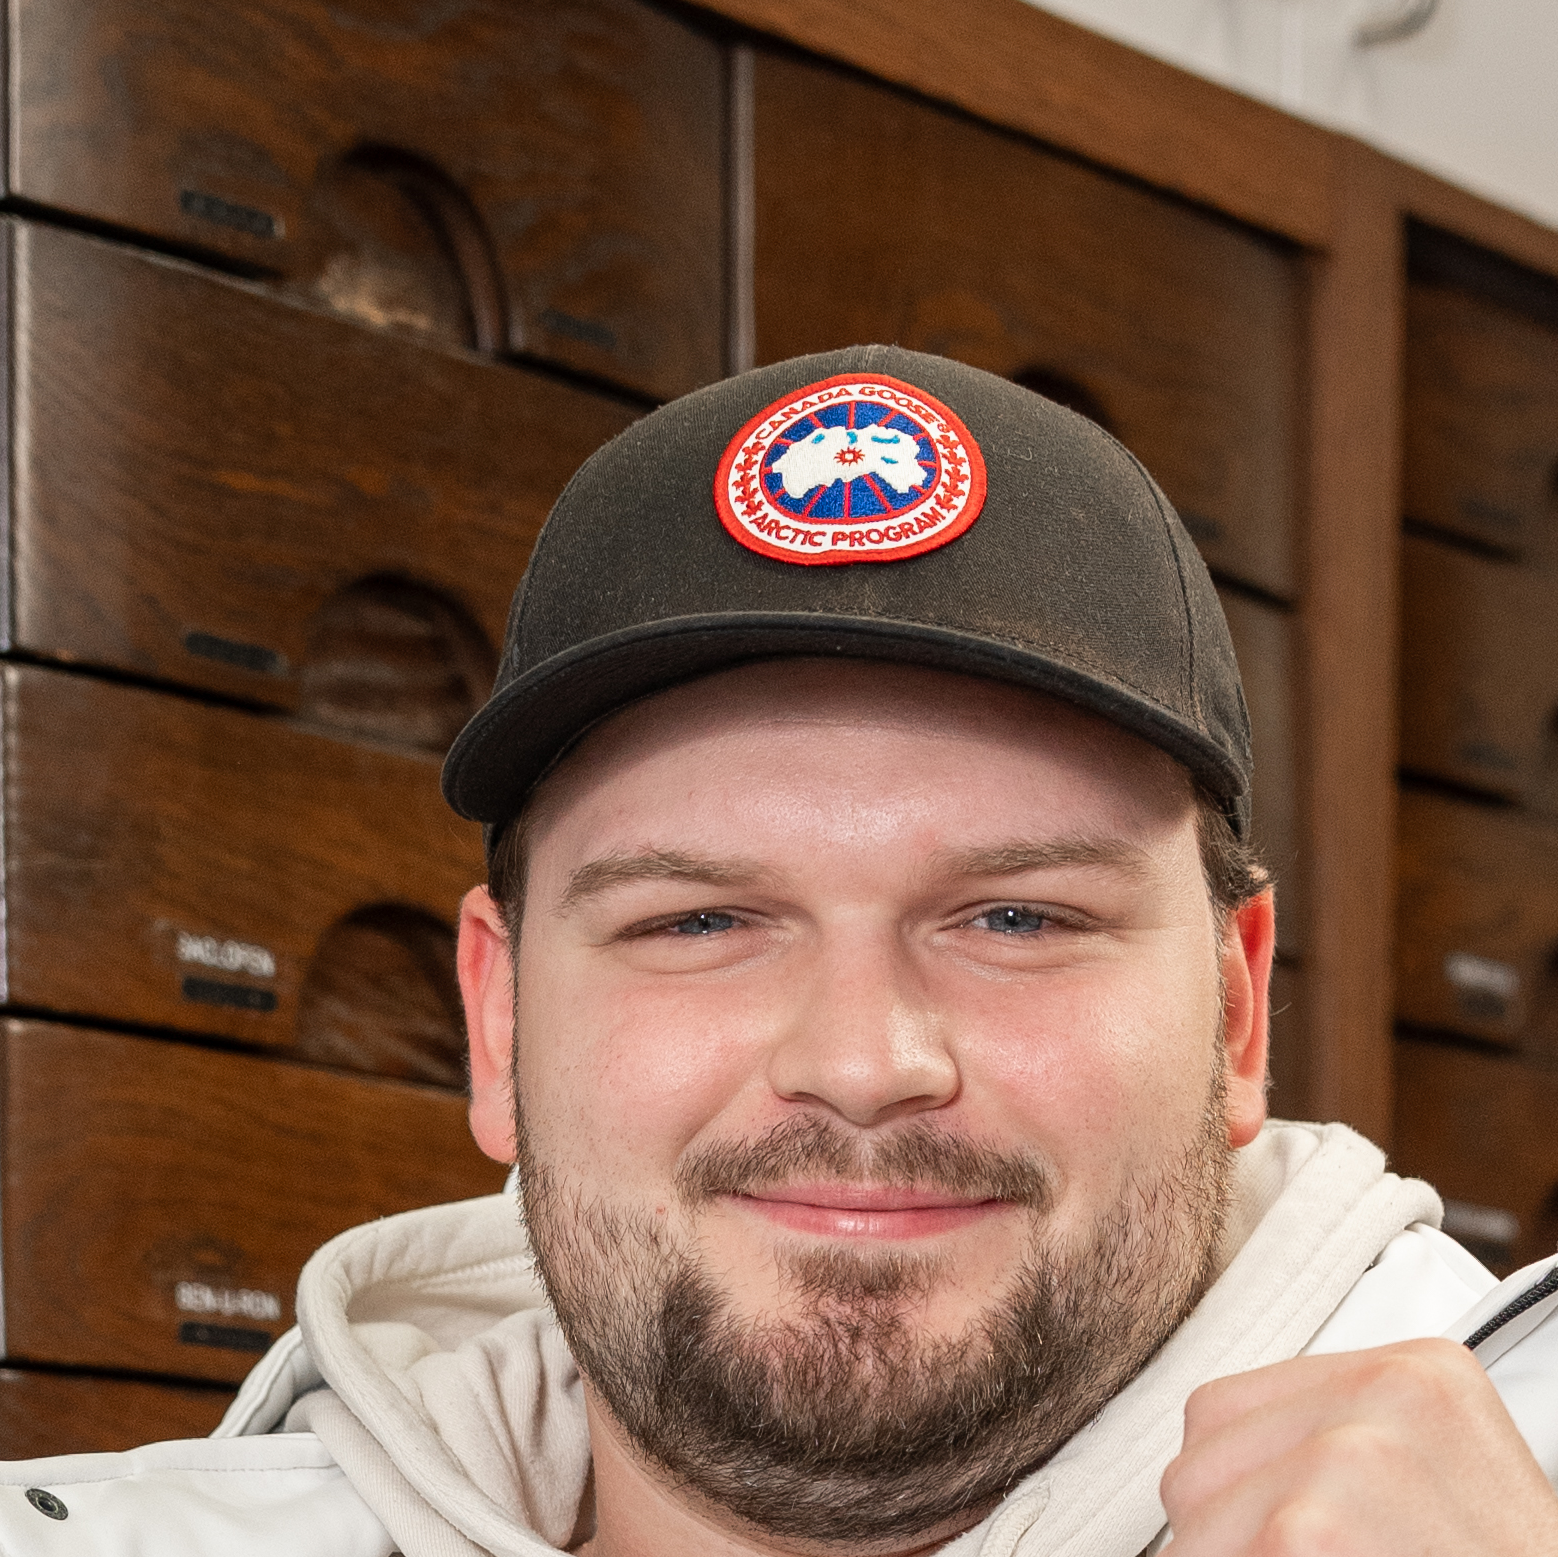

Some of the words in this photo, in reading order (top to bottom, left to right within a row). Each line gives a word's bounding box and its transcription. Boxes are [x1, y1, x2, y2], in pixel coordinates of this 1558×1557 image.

[755, 387, 854, 440] CANADA
[749, 512, 827, 547] ARCTIC
[831, 506, 946, 547] PROGRAM
